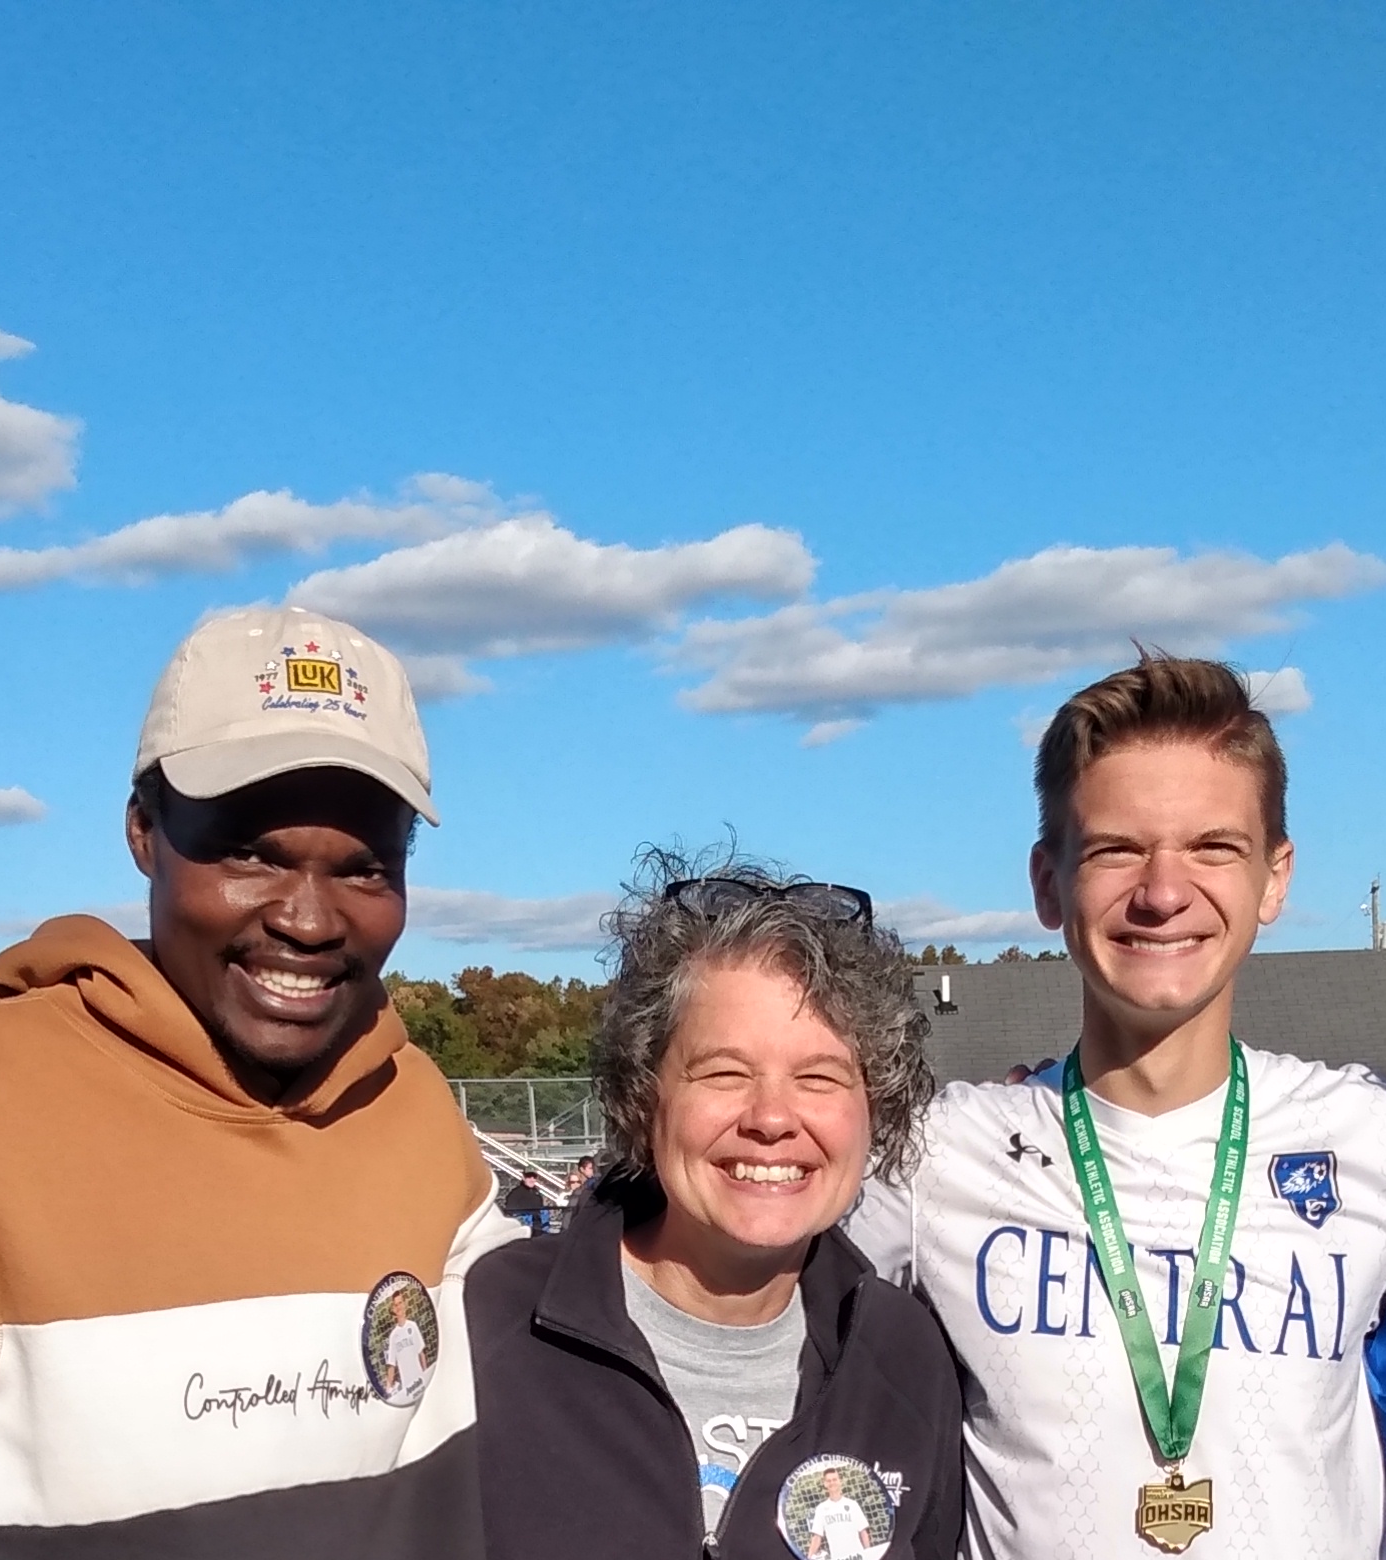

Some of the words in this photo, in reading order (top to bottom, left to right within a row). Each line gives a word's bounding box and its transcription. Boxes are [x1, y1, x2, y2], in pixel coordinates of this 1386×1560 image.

[262, 694, 320, 713] Celebrating
[323, 698, 341, 711] 25
[1229, 1105, 1244, 1141] SCHOOL
[1221, 1146, 1241, 1194] ATHLETIC
[1073, 1118, 1092, 1156] SCHOOL
[1083, 1160, 1106, 1206] ATHLETIC
[1096, 1210, 1126, 1276] ASSOCIATION
[1208, 1198, 1231, 1265] ASSOCIATION
[184, 1372, 302, 1429] Controlled
[785, 1457, 822, 1488] CENTRAL
[820, 1453, 872, 1475] CHRISTIAN
[1145, 1503, 1209, 1524] OHSAA
